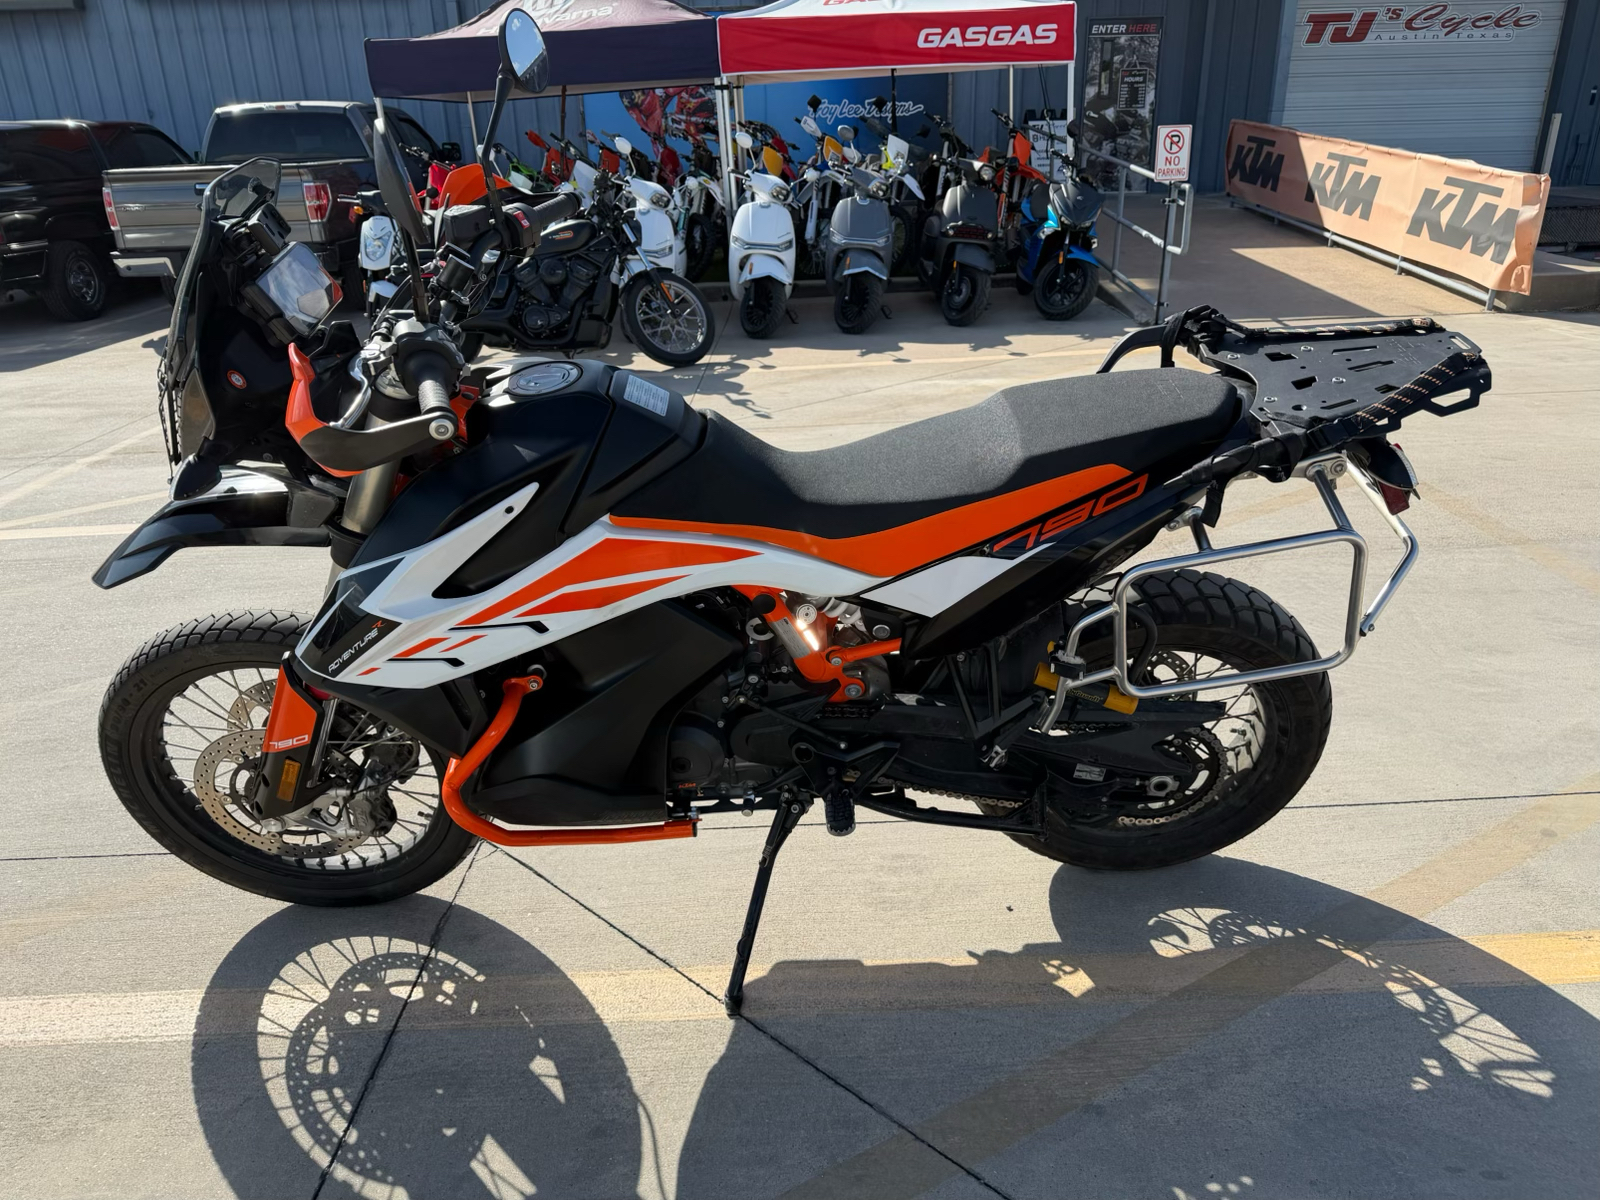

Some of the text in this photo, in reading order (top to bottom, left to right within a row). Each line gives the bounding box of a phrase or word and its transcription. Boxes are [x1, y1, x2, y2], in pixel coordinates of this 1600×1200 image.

[476, 6, 613, 35] Hvarna
[1091, 23, 1157, 34] ENTER HERE
[1305, 4, 1538, 44] TJ's Cycle
[917, 23, 1058, 48] GASGAS
[1374, 32, 1440, 41] Austin
[837, 98, 865, 118] Lee
[1157, 167, 1186, 177] PARKING
[1165, 155, 1180, 166] NO
[1230, 135, 1285, 193] KTM
[1304, 151, 1382, 222] KTM
[1405, 176, 1520, 265] KTM
[992, 473, 1149, 552] 790
[328, 627, 379, 674] ADVENTURE
[269, 734, 309, 749] 790
